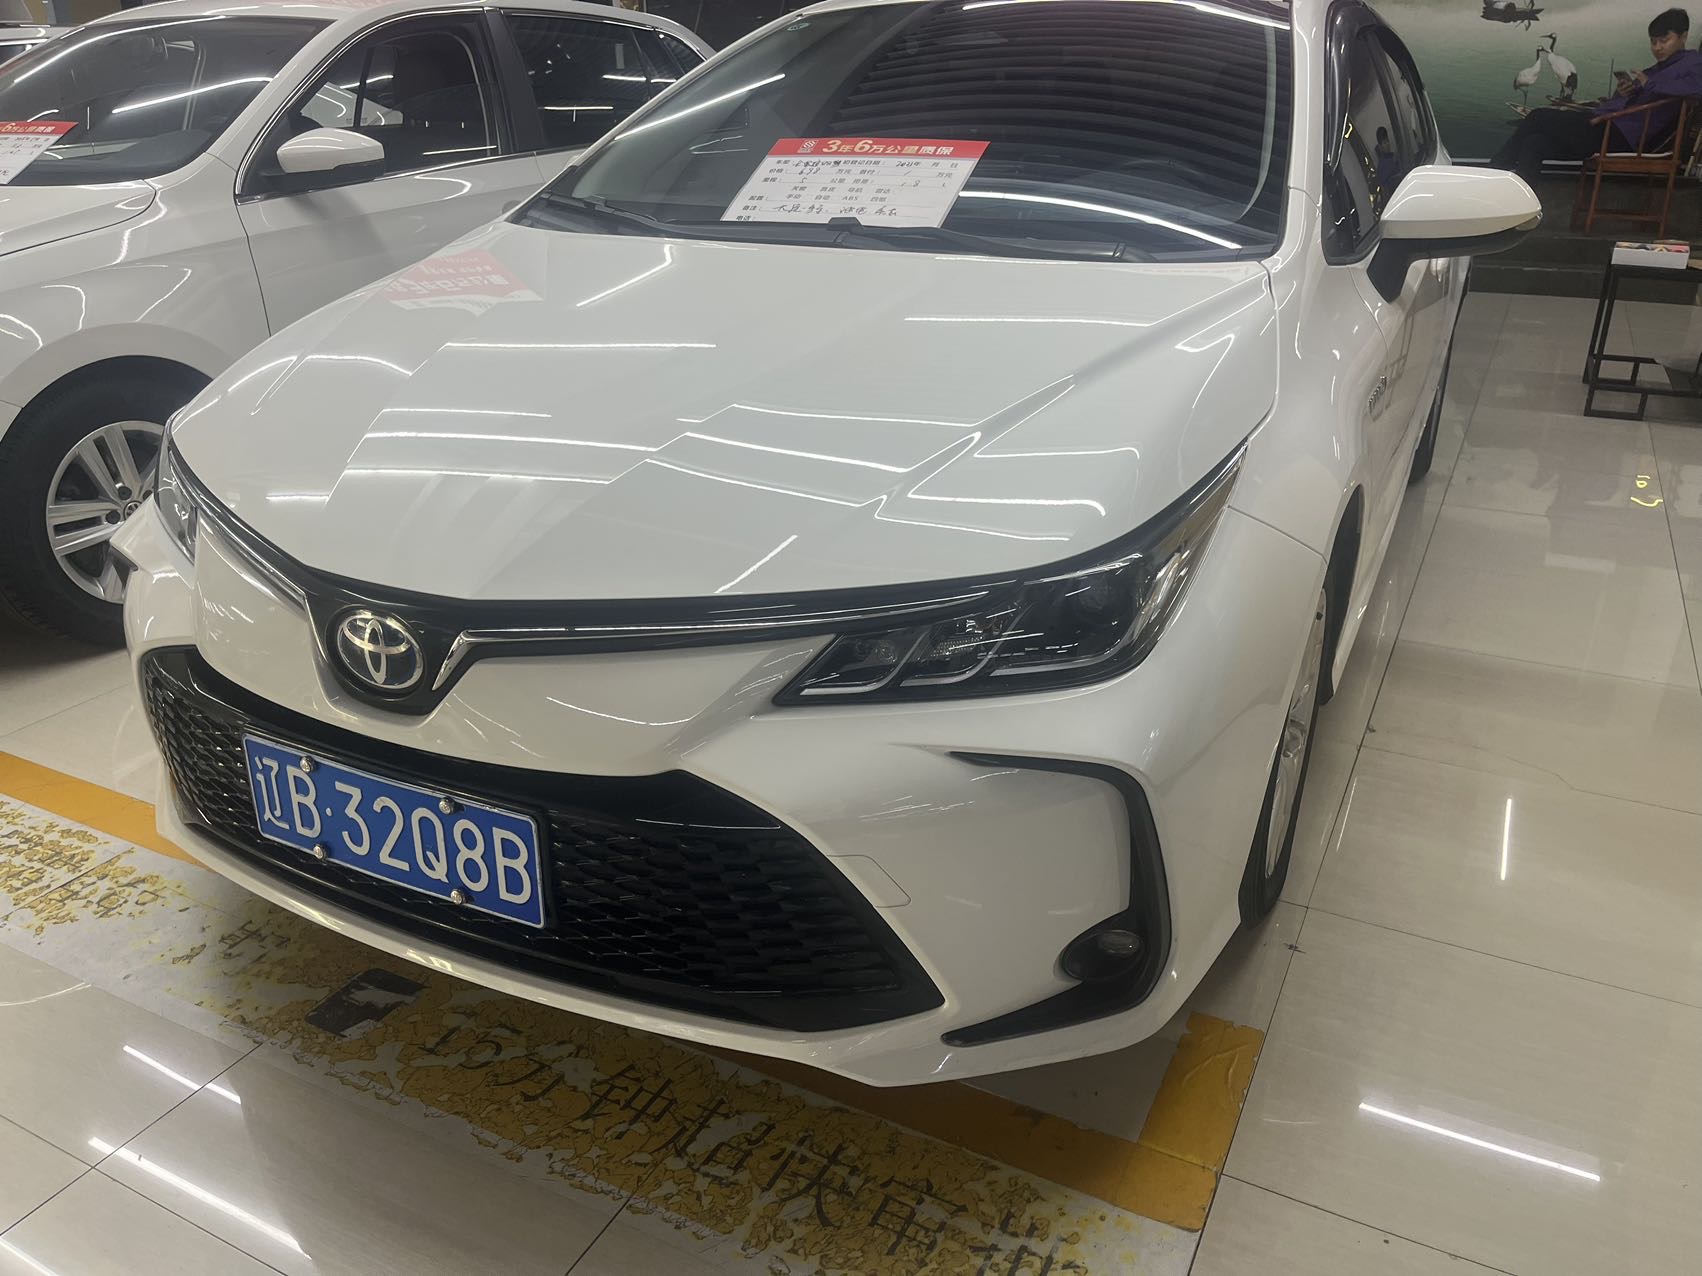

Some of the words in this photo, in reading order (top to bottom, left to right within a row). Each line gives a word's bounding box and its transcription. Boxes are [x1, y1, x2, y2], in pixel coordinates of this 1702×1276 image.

[822, 139, 954, 155] 3年6万公里质保
[254, 755, 533, 905] 辽B·32Q8B
